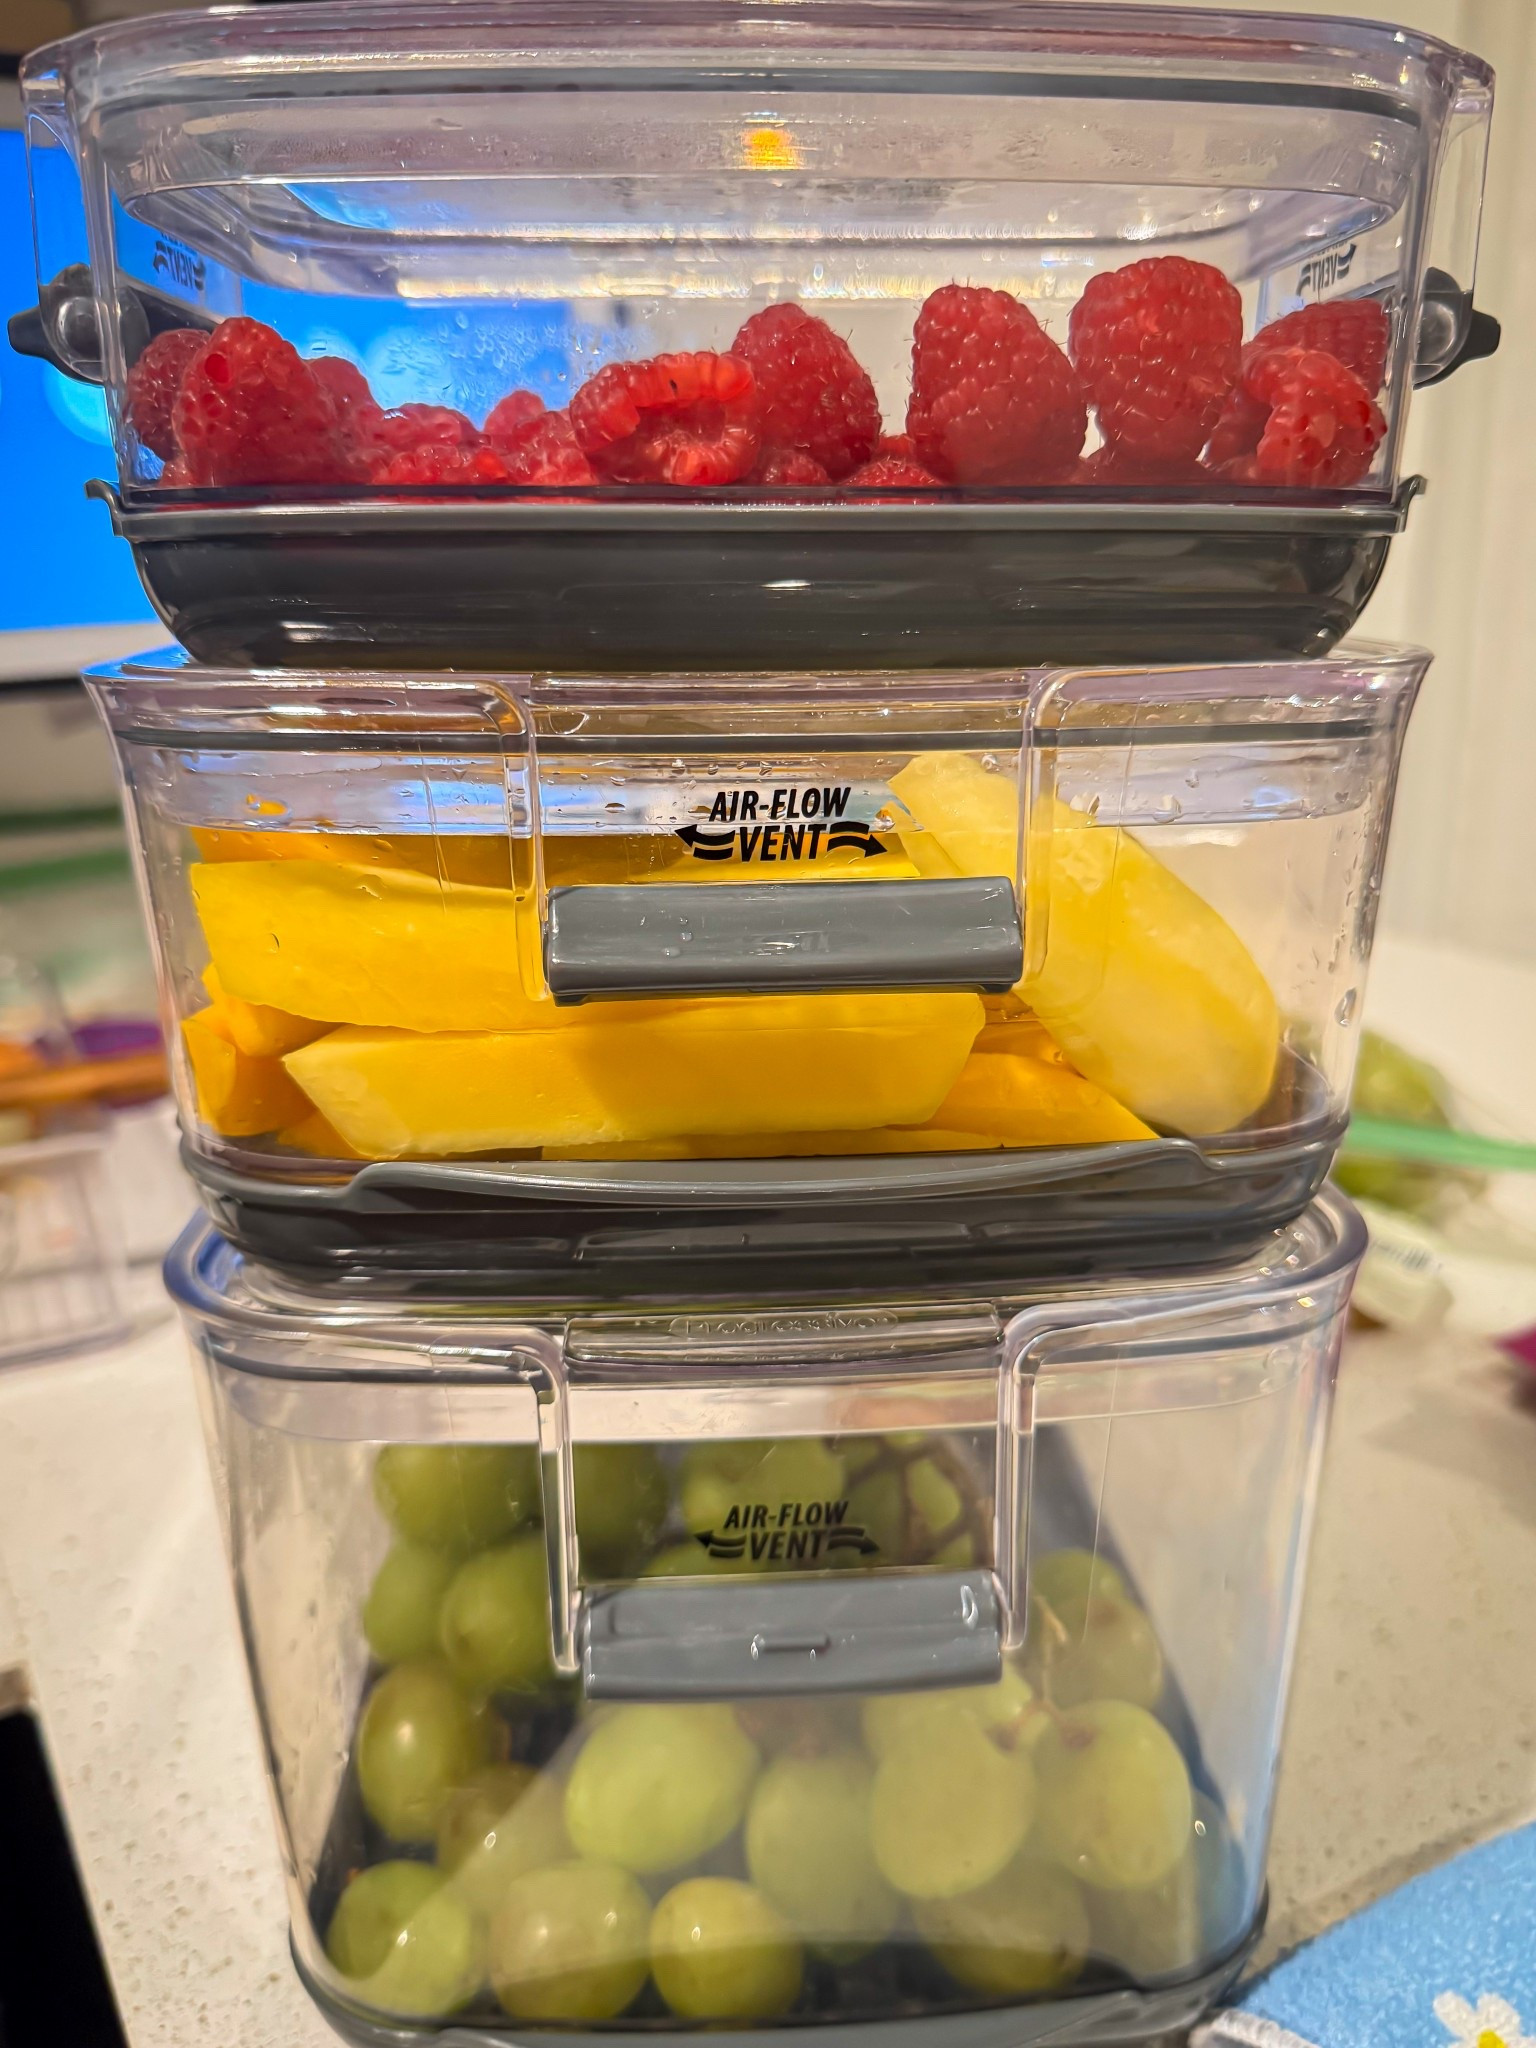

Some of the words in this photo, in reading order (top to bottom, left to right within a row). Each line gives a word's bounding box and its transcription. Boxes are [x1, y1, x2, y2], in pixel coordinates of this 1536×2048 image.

[708, 787, 851, 823] AIR-FLOW
[739, 823, 828, 863] VENT
[723, 1501, 849, 1529] AIR-FLOW
[751, 1529, 828, 1560] VENT
